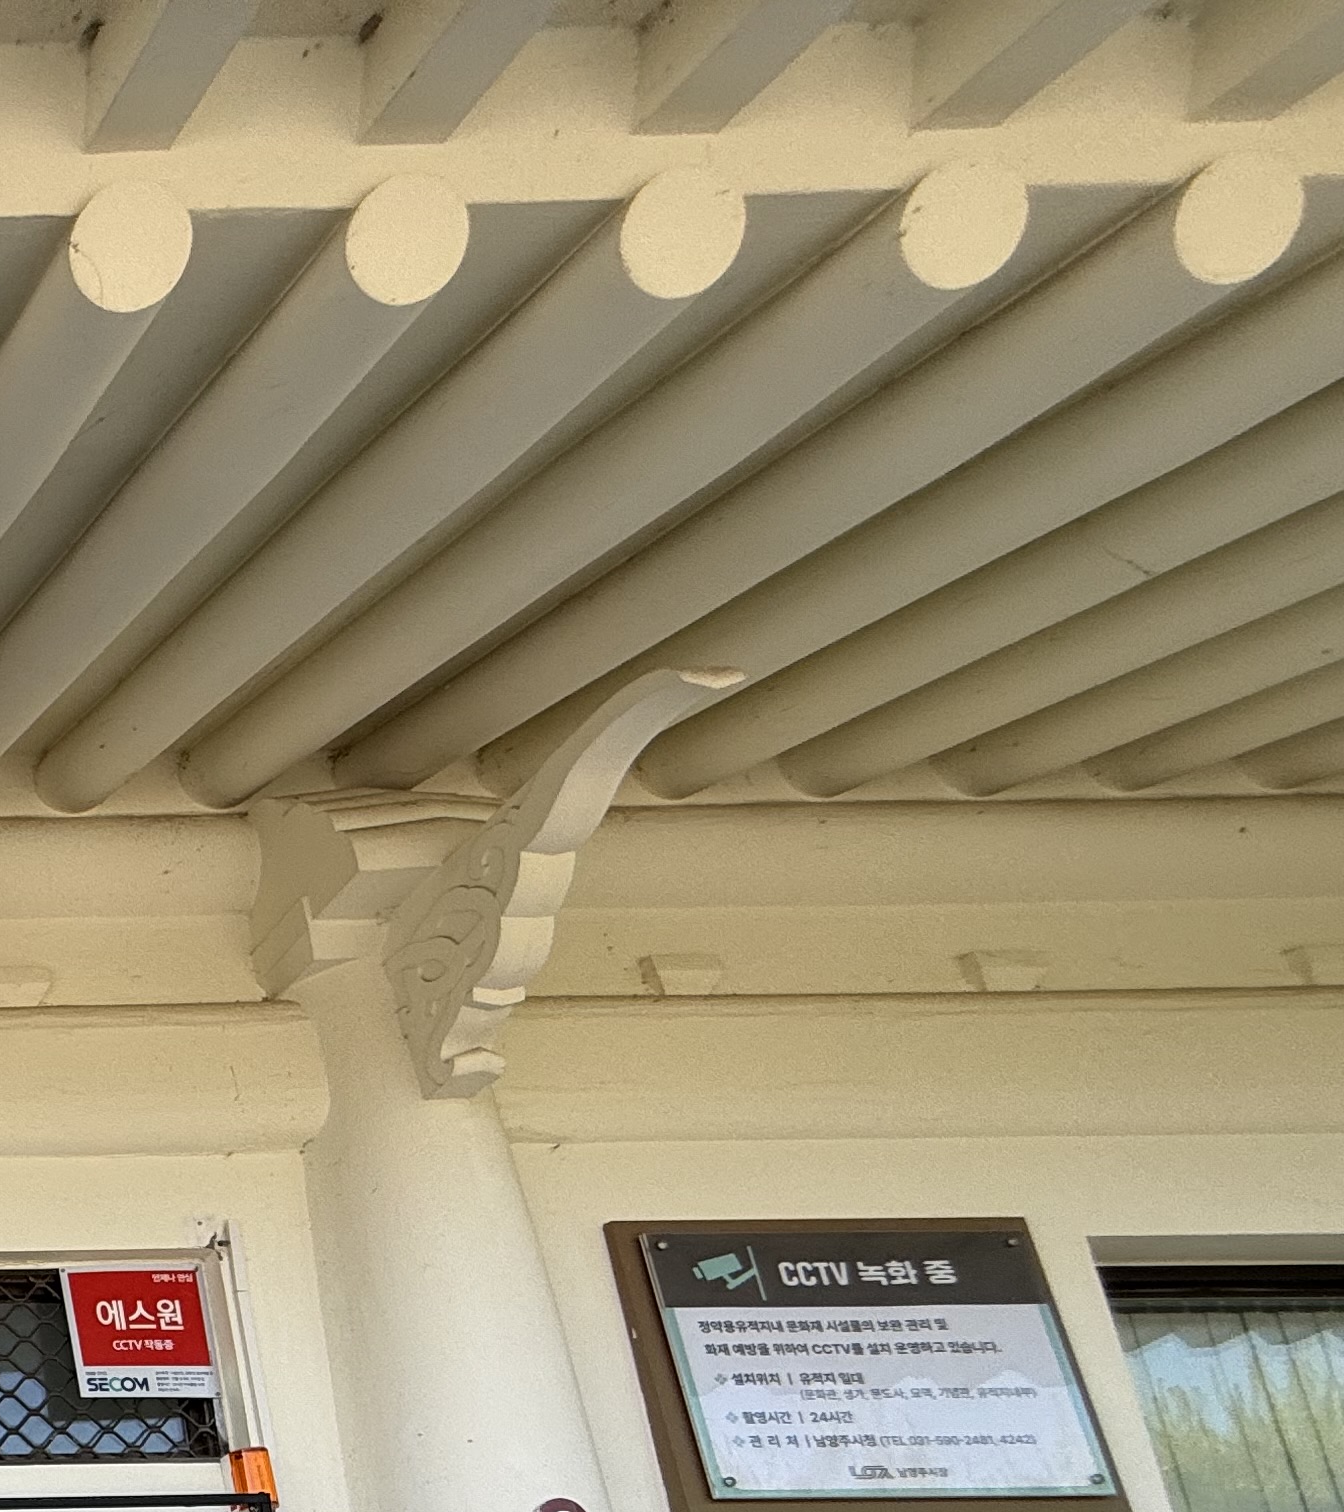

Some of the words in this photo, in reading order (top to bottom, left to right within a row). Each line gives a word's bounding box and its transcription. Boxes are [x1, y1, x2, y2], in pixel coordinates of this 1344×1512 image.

[777, 1261, 849, 1286] CCTV
[856, 1260, 918, 1286] 녹화
[922, 1260, 958, 1284] 중
[96, 1299, 184, 1331] 에스원
[698, 1320, 785, 1333] 정약용유적지내
[786, 1320, 824, 1333] 문화재
[934, 1318, 949, 1330] 및
[112, 1340, 142, 1351] CCTV
[144, 1340, 175, 1351] 작동중
[704, 1343, 730, 1356] 화재
[732, 1343, 770, 1356] 예방을
[773, 1343, 810, 1356] 위하여
[812, 1343, 864, 1355] CCTV를
[867, 1342, 892, 1355] 설치
[894, 1342, 946, 1354] 운영하고
[947, 1341, 1003, 1354] 있습니다.
[86, 1377, 150, 1392] SECOM
[731, 1373, 781, 1385] 설치위치
[799, 1373, 836, 1385] 유적지
[838, 1373, 865, 1385] 일대
[742, 1411, 793, 1424] 촬영시간
[809, 1411, 854, 1424] 24시간
[814, 1434, 877, 1448] 남양주시청
